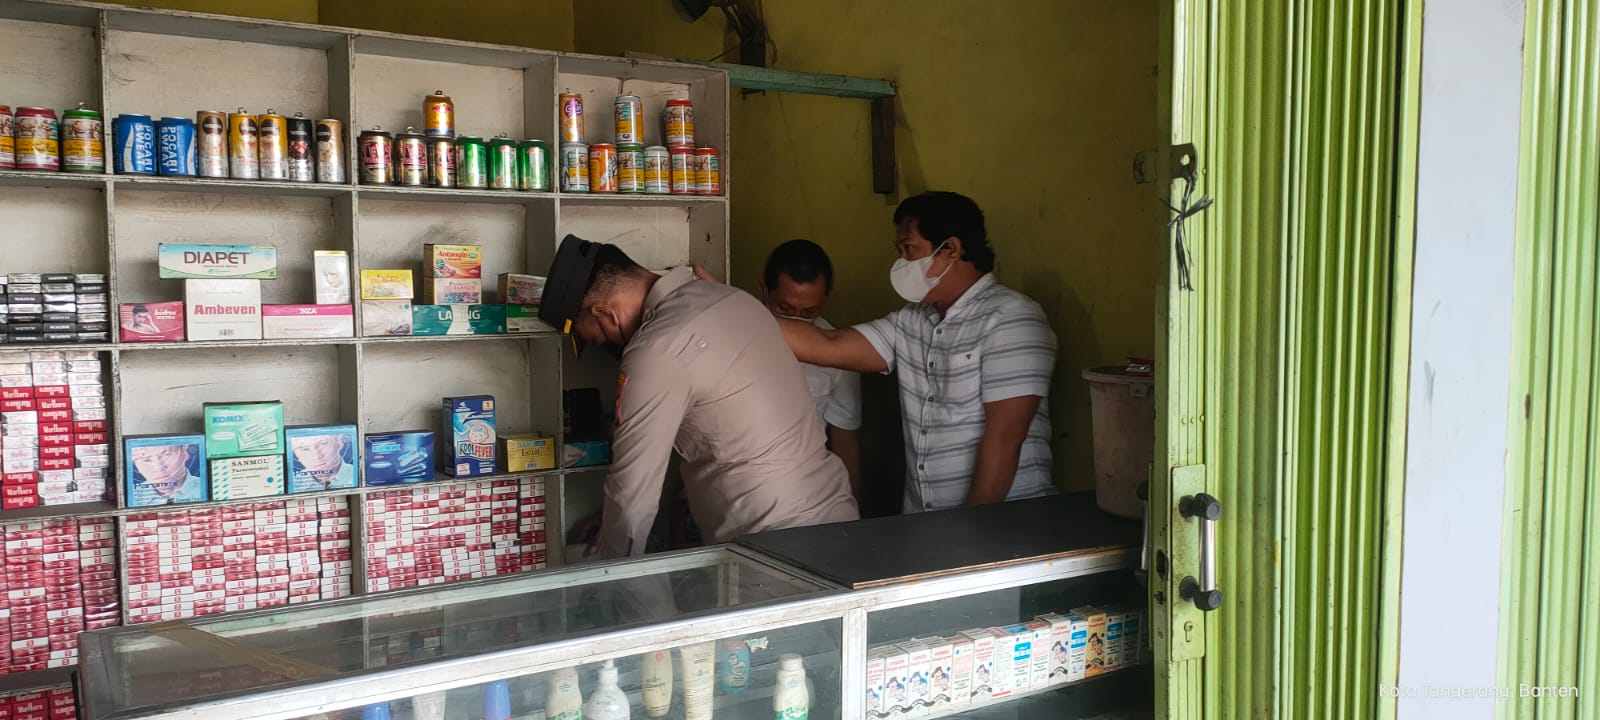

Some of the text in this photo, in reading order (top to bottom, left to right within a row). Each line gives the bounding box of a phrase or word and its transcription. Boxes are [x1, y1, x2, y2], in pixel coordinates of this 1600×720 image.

[135, 122, 145, 166] SWEAT
[143, 124, 153, 171] POCARI
[161, 127, 169, 168] SWEAT
[168, 126, 178, 172] POCARI
[183, 251, 250, 264] DIAPET
[194, 304, 256, 315] Ambeven
[3, 389, 29, 398] Marlboro
[41, 399, 67, 409] Marlboro
[43, 424, 68, 433] Marlboro
[474, 445, 493, 457] FEVER
[231, 459, 269, 467] SANMOL
[7, 486, 33, 495] Marlboro
[17, 702, 43, 713] Marlboro
